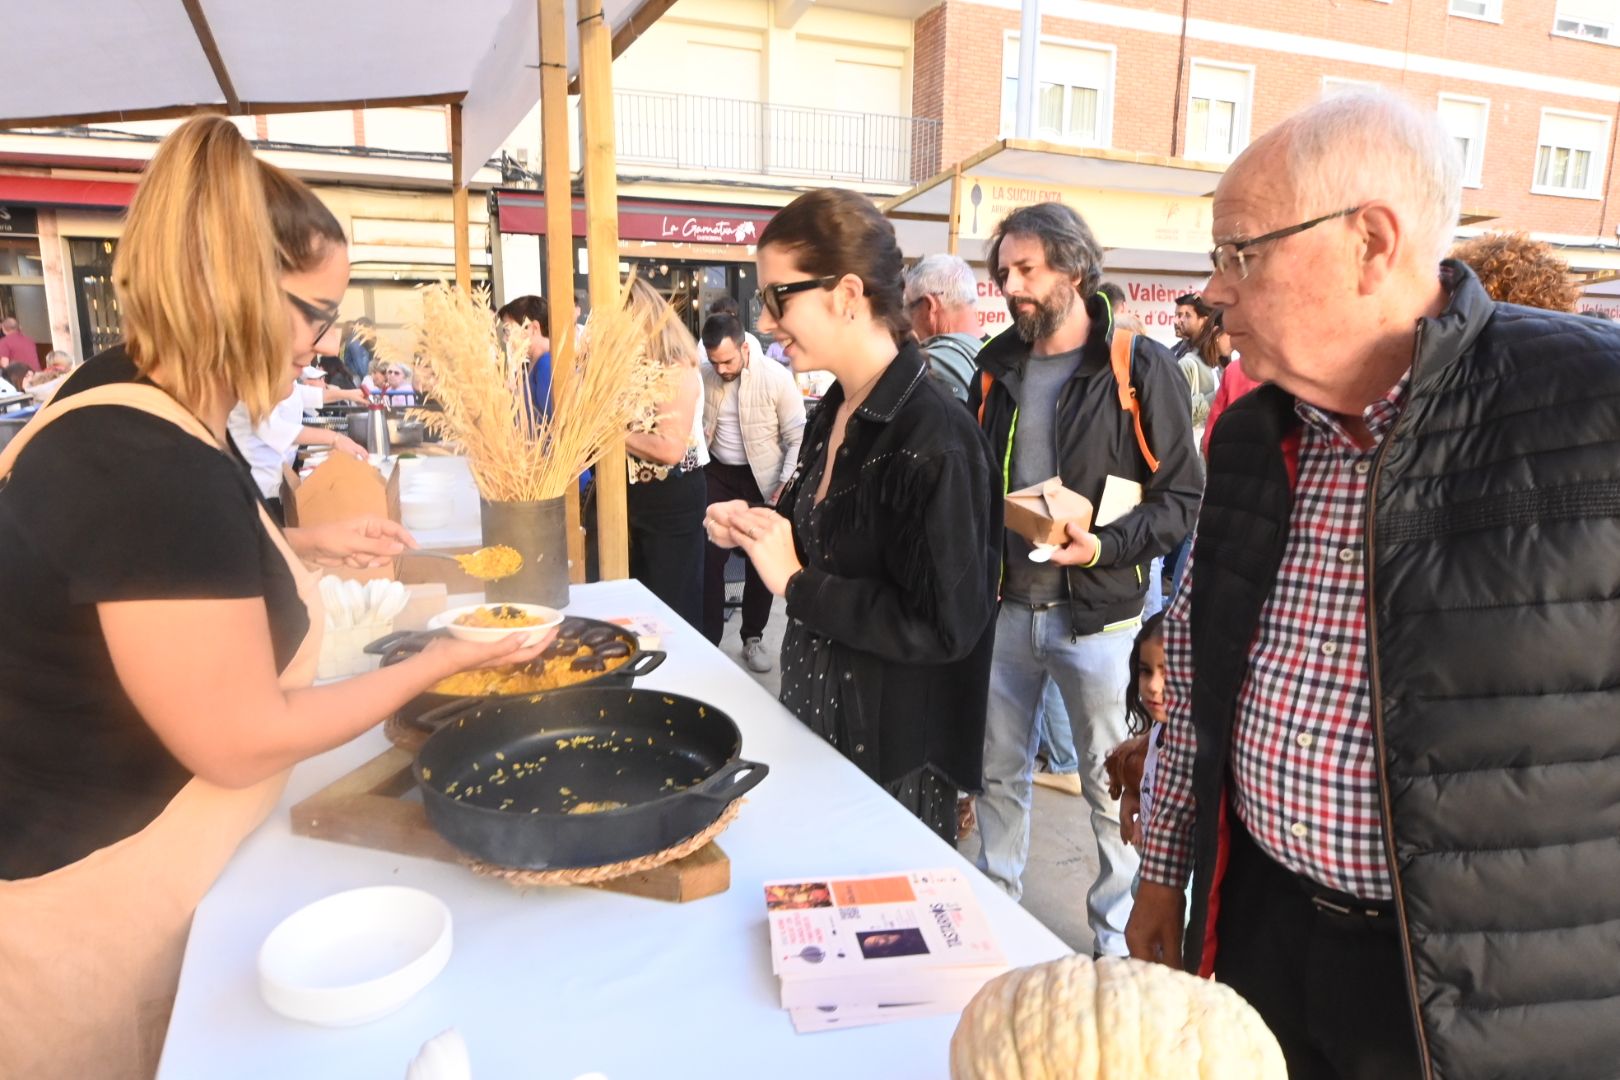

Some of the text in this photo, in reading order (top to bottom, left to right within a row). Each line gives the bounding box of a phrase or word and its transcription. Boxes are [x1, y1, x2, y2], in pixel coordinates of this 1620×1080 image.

[992, 186, 1062, 203] LA SUCULENTA
[662, 216, 678, 237] La
